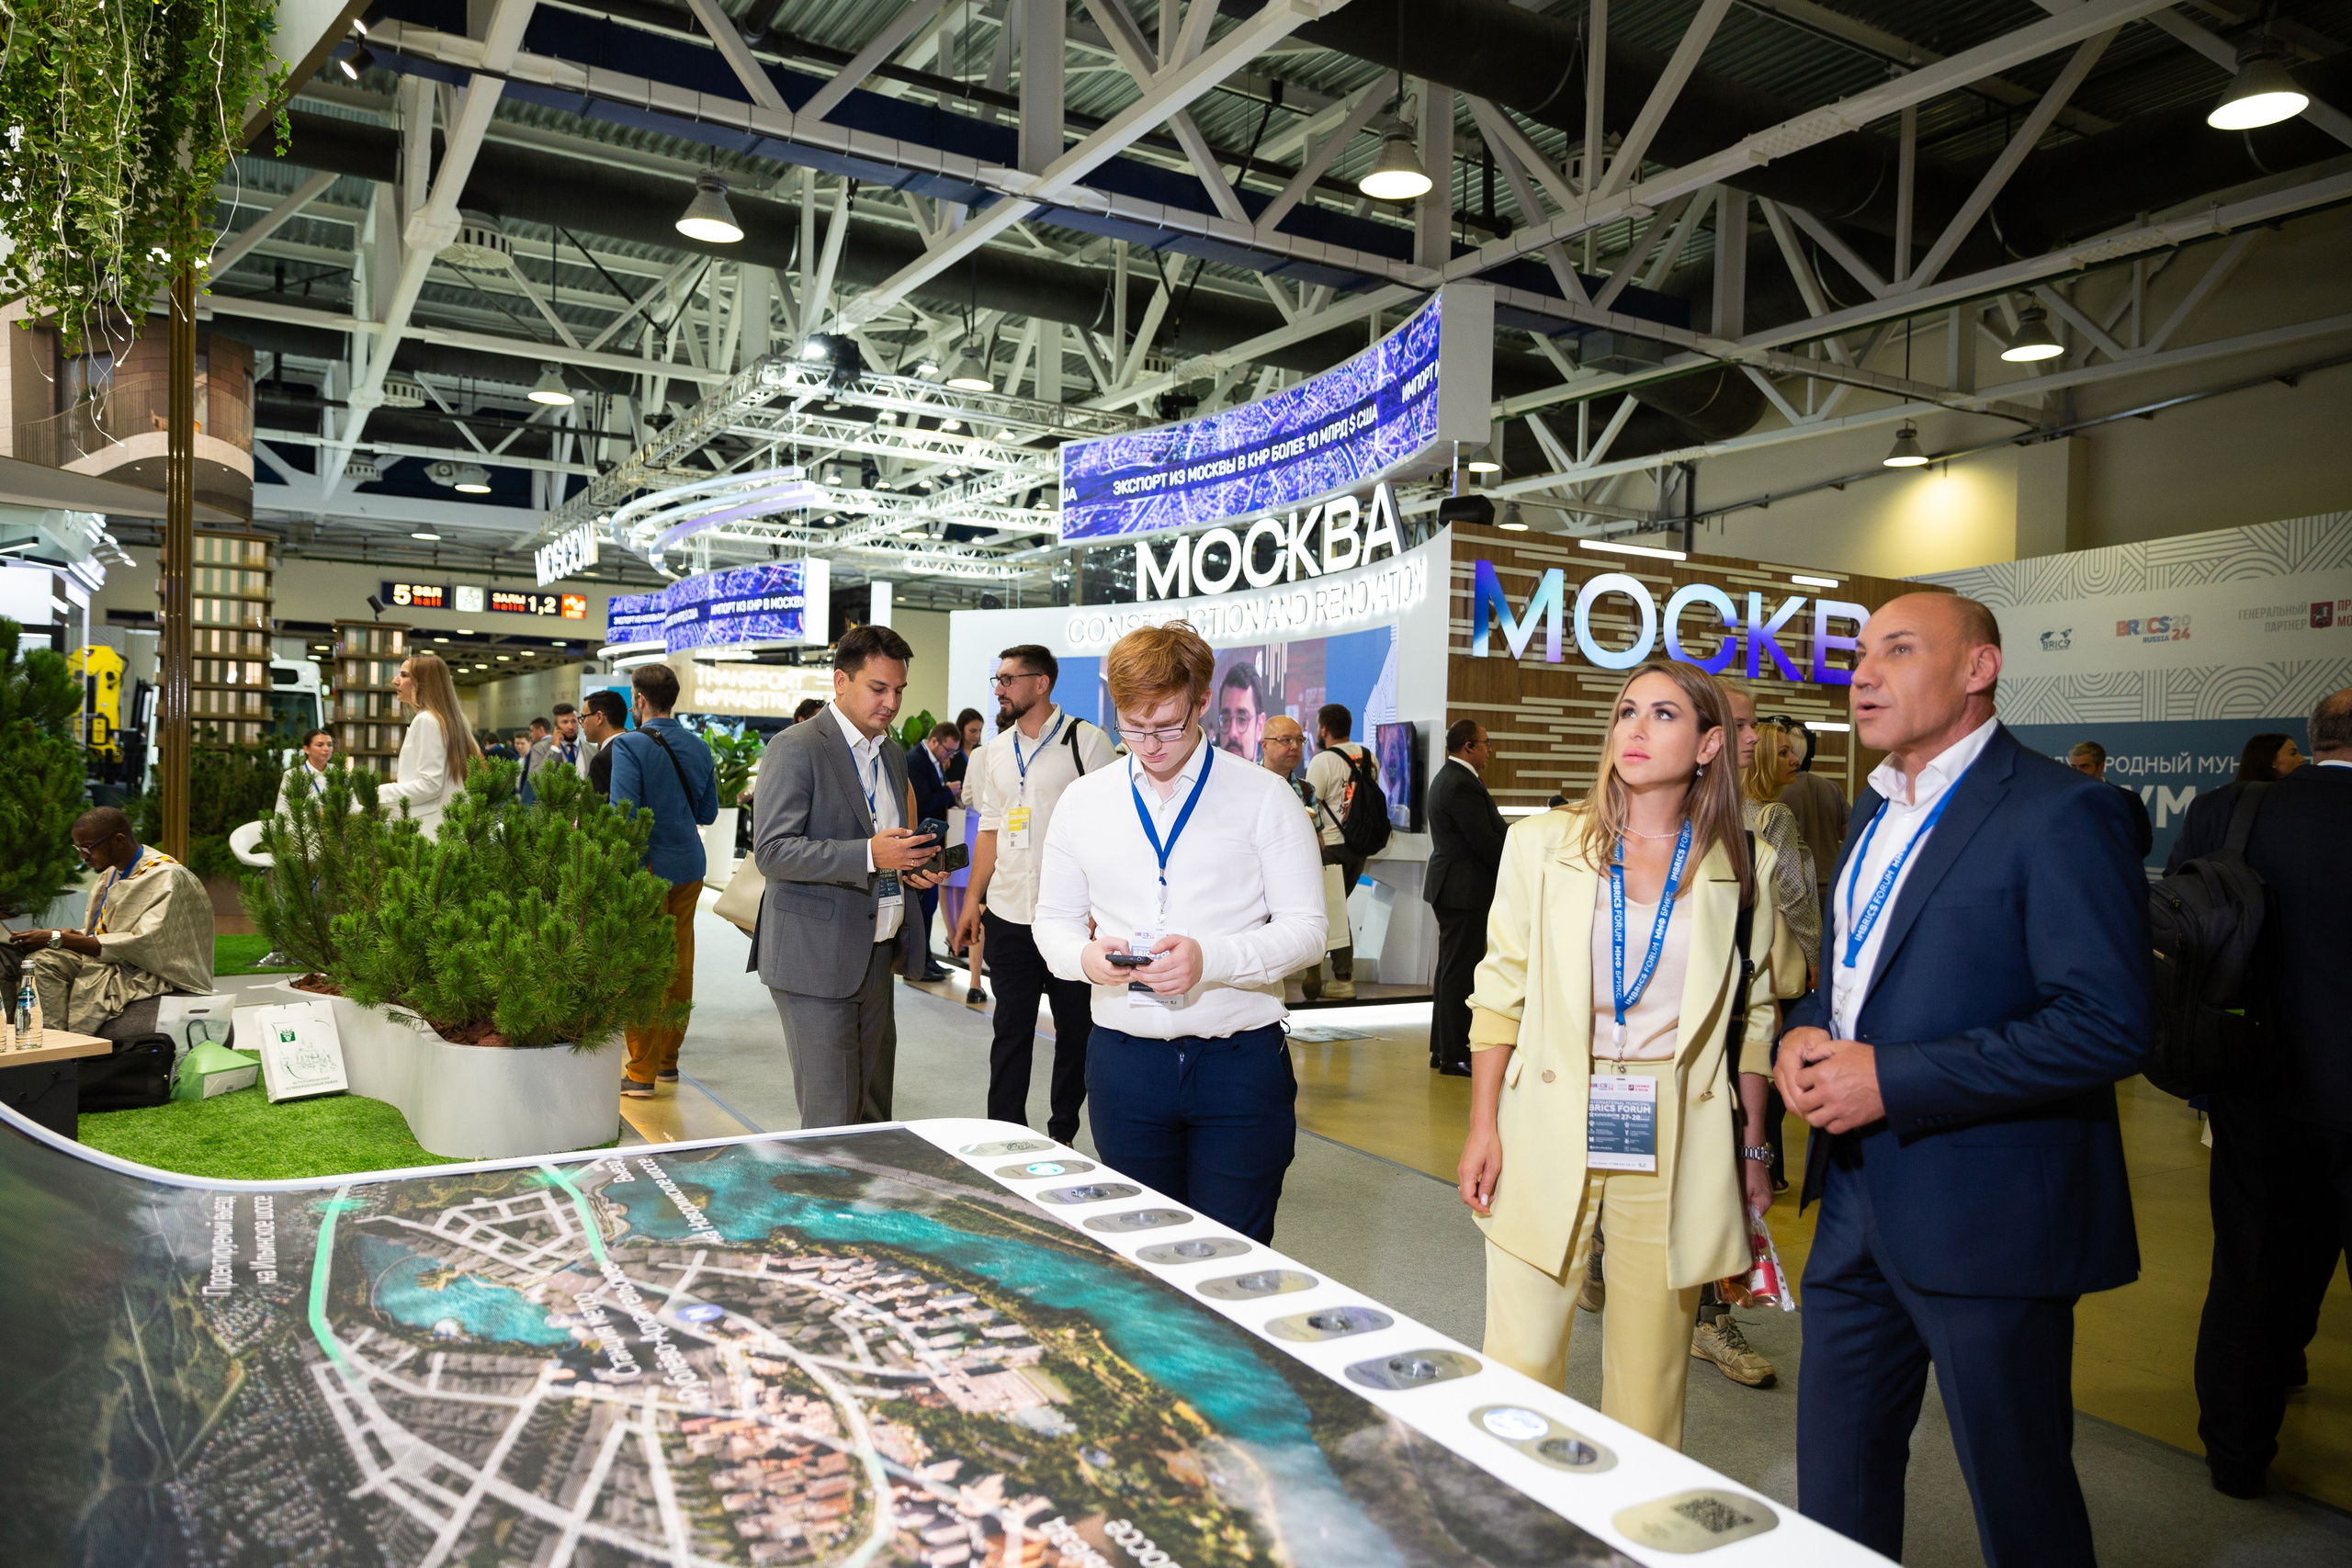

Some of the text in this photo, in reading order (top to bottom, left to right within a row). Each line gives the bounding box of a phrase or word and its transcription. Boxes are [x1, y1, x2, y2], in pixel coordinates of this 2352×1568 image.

[1401, 367, 1435, 403] ИМПОРТ
[1113, 403, 1378, 496] ЭКСПОРТ ИЗ МОСКВЫ В КНР БОЛЕЕ 10 МЛРД $ США
[535, 521, 595, 588] MOSCOW
[1135, 482, 1402, 602] МОСКВА
[393, 583, 412, 605] 5
[413, 596, 442, 607] hall
[492, 592, 526, 604] ЗАЛЫ
[710, 602, 736, 616] ИМПОРТ
[736, 600, 747, 613] ИЗ
[747, 598, 763, 612] КНР
[763, 598, 770, 611] В
[1264, 593, 1308, 629] AND
[1315, 558, 1426, 623] RENOVATION
[2238, 601, 2308, 621] ГЕНЕРАЛЬНЫЙ
[2264, 618, 2308, 633] ПАРТНЕР
[2143, 635, 2170, 644] RUSSIA
[695, 664, 803, 690] TRANSPORT
[1854, 904, 1879, 942] IMBRICS
[1871, 869, 1895, 906] FORUM
[1613, 909, 1623, 942] FORUM
[1614, 970, 1623, 999] БРИКС
[1623, 973, 1647, 1006] IMBRICS
[1643, 942, 1660, 974] FORUM
[1589, 1104, 1651, 1114] BRICS FORUM
[638, 1158, 668, 1179] шоссе
[656, 1178, 713, 1232] Новорижское
[248, 1195, 278, 1284] на Ильинское шоссе
[202, 1221, 239, 1296] Проектируемый
[572, 1292, 641, 1378] Станция метро
